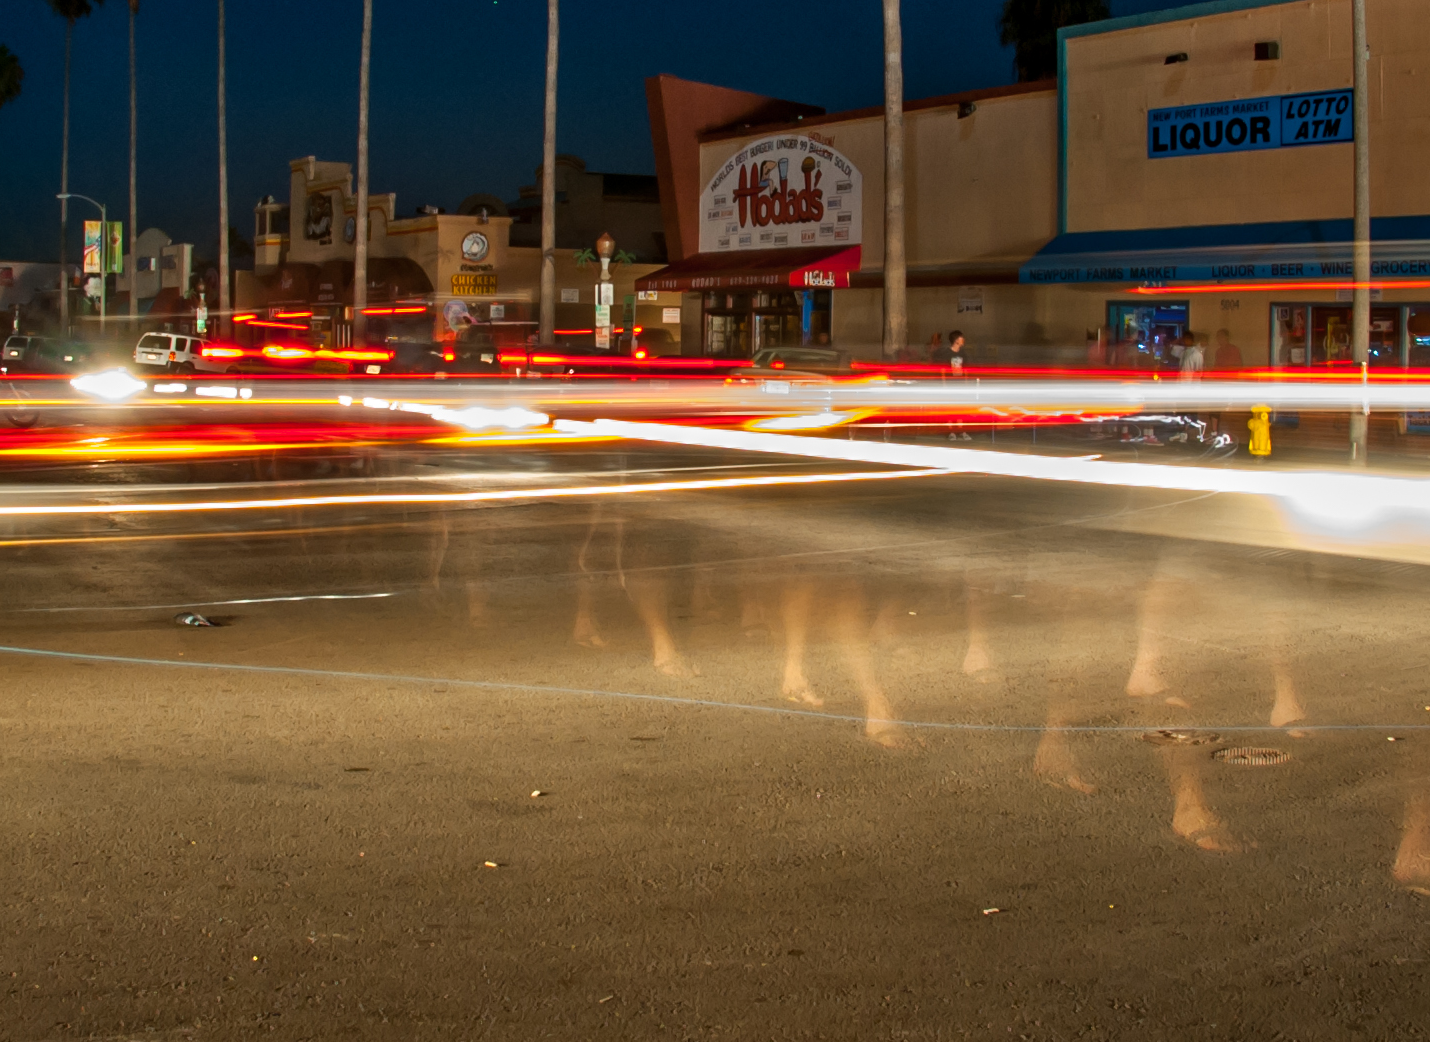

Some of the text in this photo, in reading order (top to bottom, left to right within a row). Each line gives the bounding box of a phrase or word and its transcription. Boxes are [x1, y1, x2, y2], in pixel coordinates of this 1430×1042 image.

[1153, 101, 1270, 123] NEW PORT FARMS MARKET
[1285, 95, 1350, 120] LOTTO
[1152, 115, 1271, 153] LIQUOR
[1294, 118, 1341, 141] ATM
[776, 138, 799, 150] UNDER
[799, 140, 809, 152] 99
[452, 275, 496, 285] CHICKEN
[1029, 267, 1081, 281] NEWPORT
[1086, 267, 1124, 280] FARMS
[1129, 265, 1178, 279] MARKET
[1211, 264, 1256, 277] LIQUOR
[1271, 262, 1304, 276] BEER
[1321, 261, 1354, 275] WINE
[453, 285, 497, 295] KITCHEN
